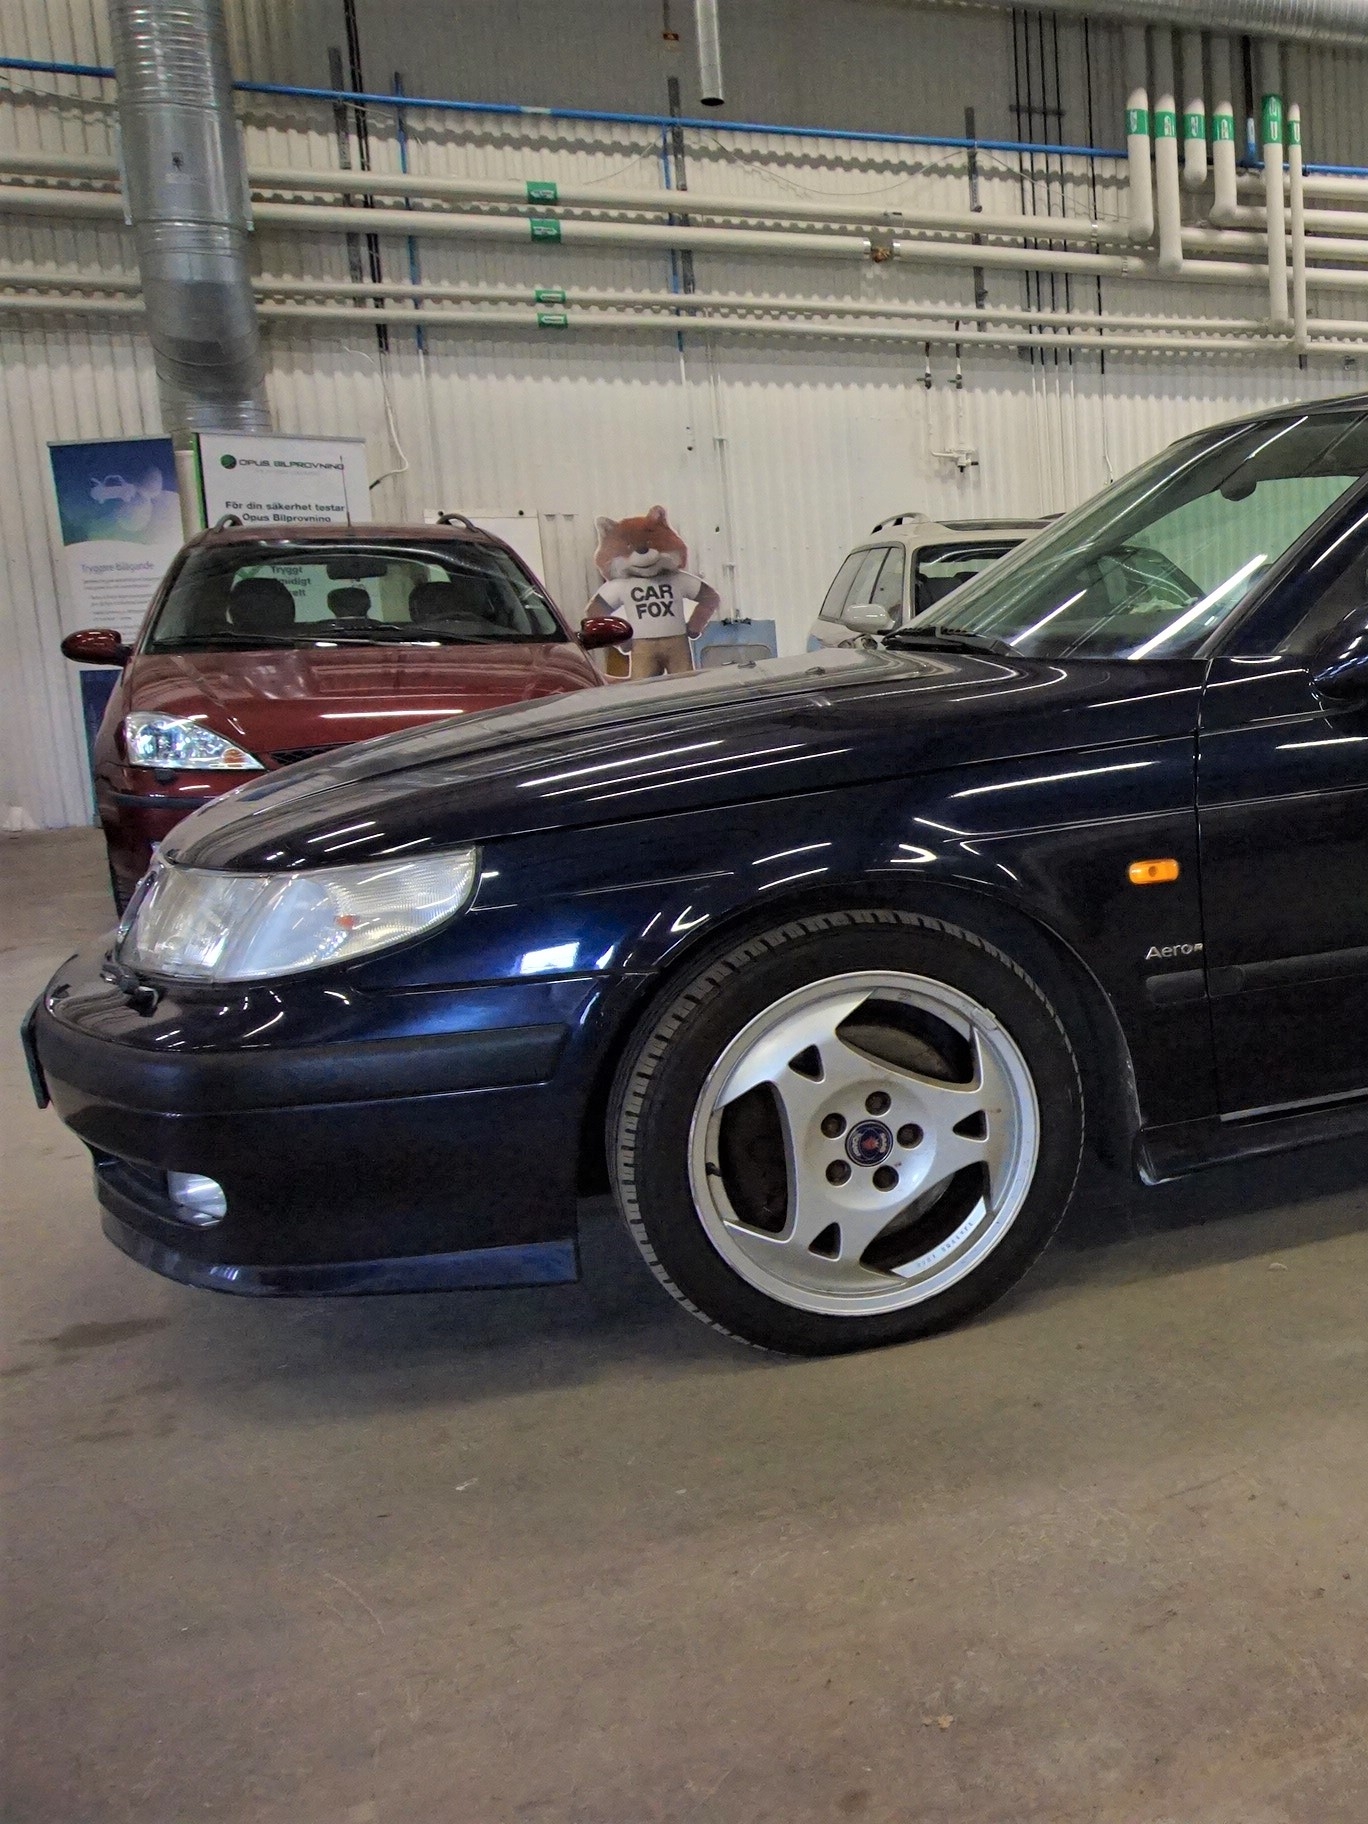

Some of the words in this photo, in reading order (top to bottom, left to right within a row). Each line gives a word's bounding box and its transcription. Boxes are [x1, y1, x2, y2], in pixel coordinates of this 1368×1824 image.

[239, 459, 270, 467] OPUS
[225, 501, 243, 510] För
[246, 502, 263, 511] din
[266, 503, 312, 512] säkerhet
[315, 504, 345, 512] testar
[242, 513, 270, 523] Opus
[630, 584, 674, 602] CAR
[635, 600, 675, 619] FOX
[1145, 943, 1194, 960] Aero
